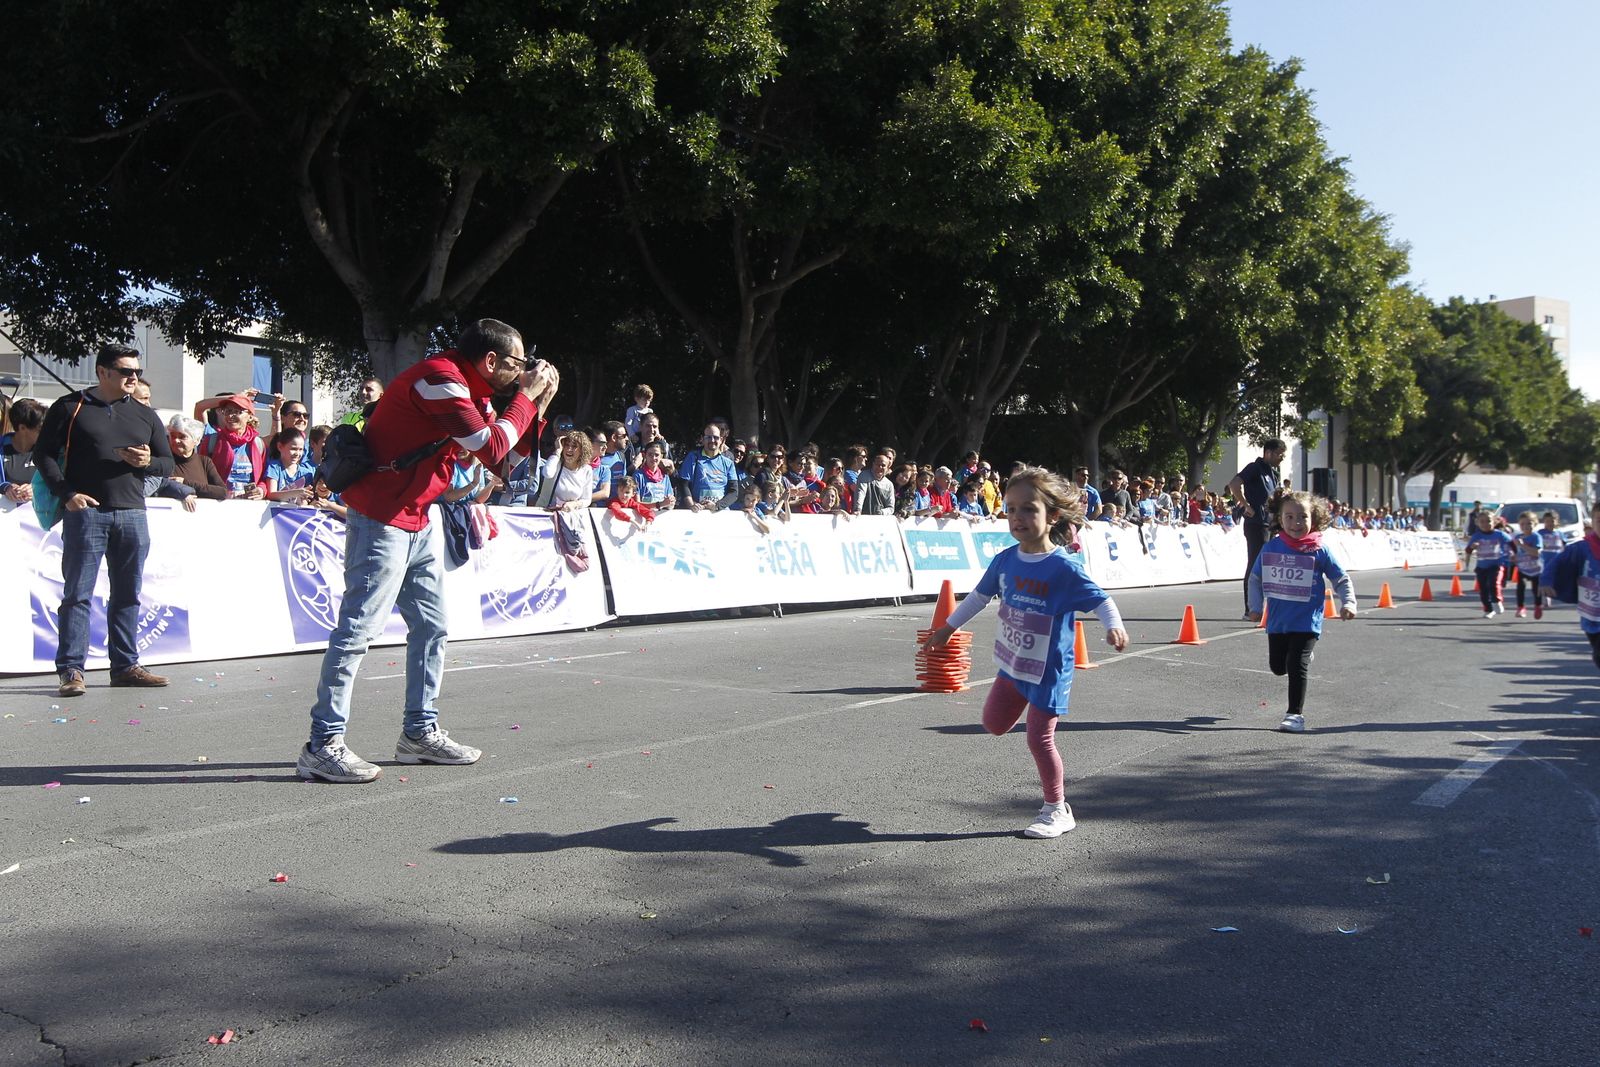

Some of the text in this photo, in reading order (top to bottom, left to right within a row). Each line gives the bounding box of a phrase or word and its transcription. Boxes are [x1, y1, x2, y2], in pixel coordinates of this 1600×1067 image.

[841, 540, 900, 575] NEXA
[1271, 566, 1304, 581] 3102
[1012, 594, 1047, 607] CARRERA
[1001, 622, 1036, 650] 3269
